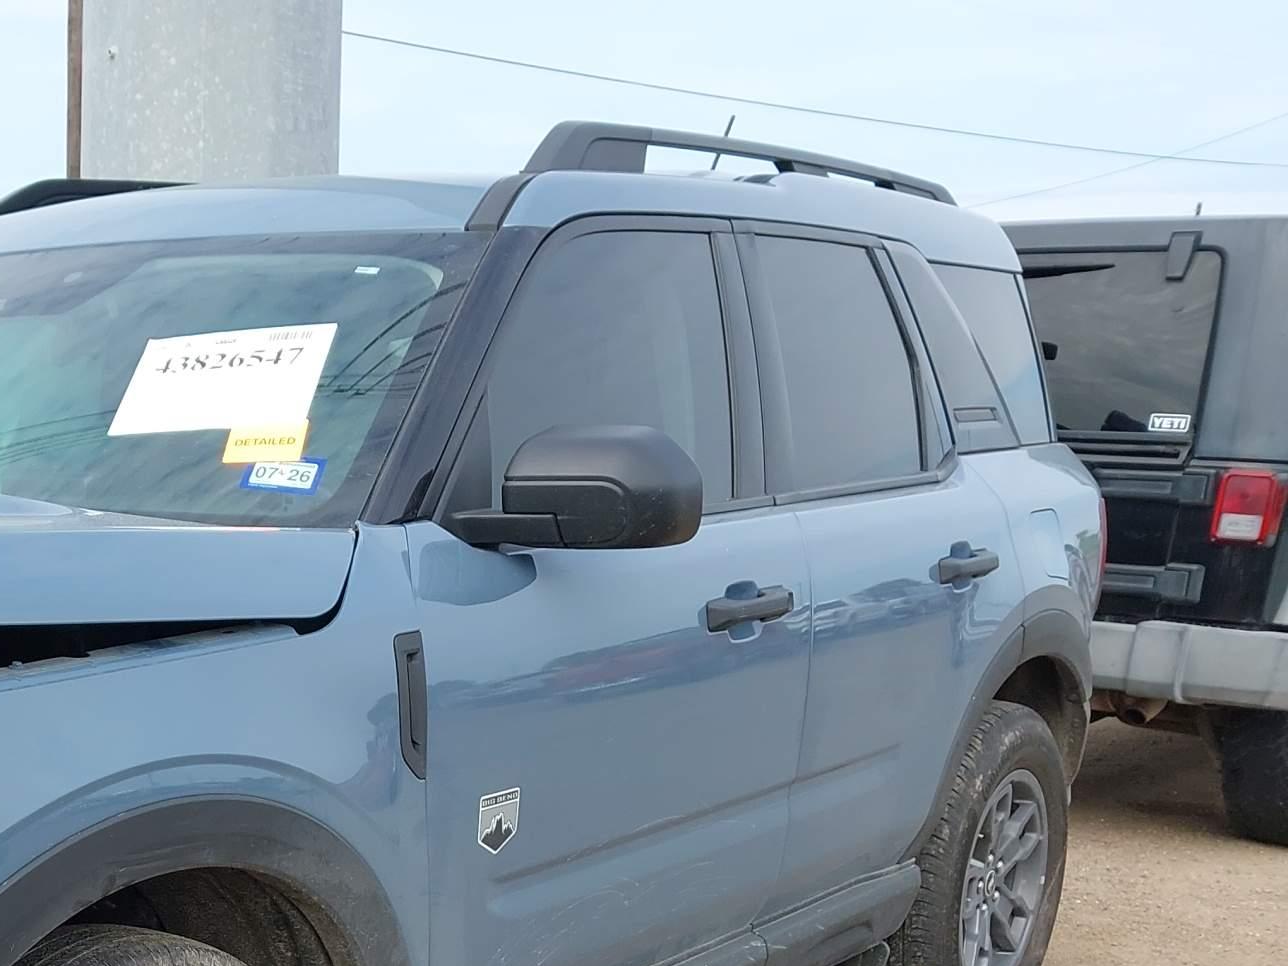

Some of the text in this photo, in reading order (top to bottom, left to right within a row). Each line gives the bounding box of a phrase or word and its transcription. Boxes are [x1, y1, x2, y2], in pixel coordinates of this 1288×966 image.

[155, 346, 305, 375] 43826547
[1153, 416, 1187, 429] YETI
[234, 436, 297, 448] DETAILED
[255, 465, 312, 483] 07 26
[482, 791, 518, 807] BIG BEND
